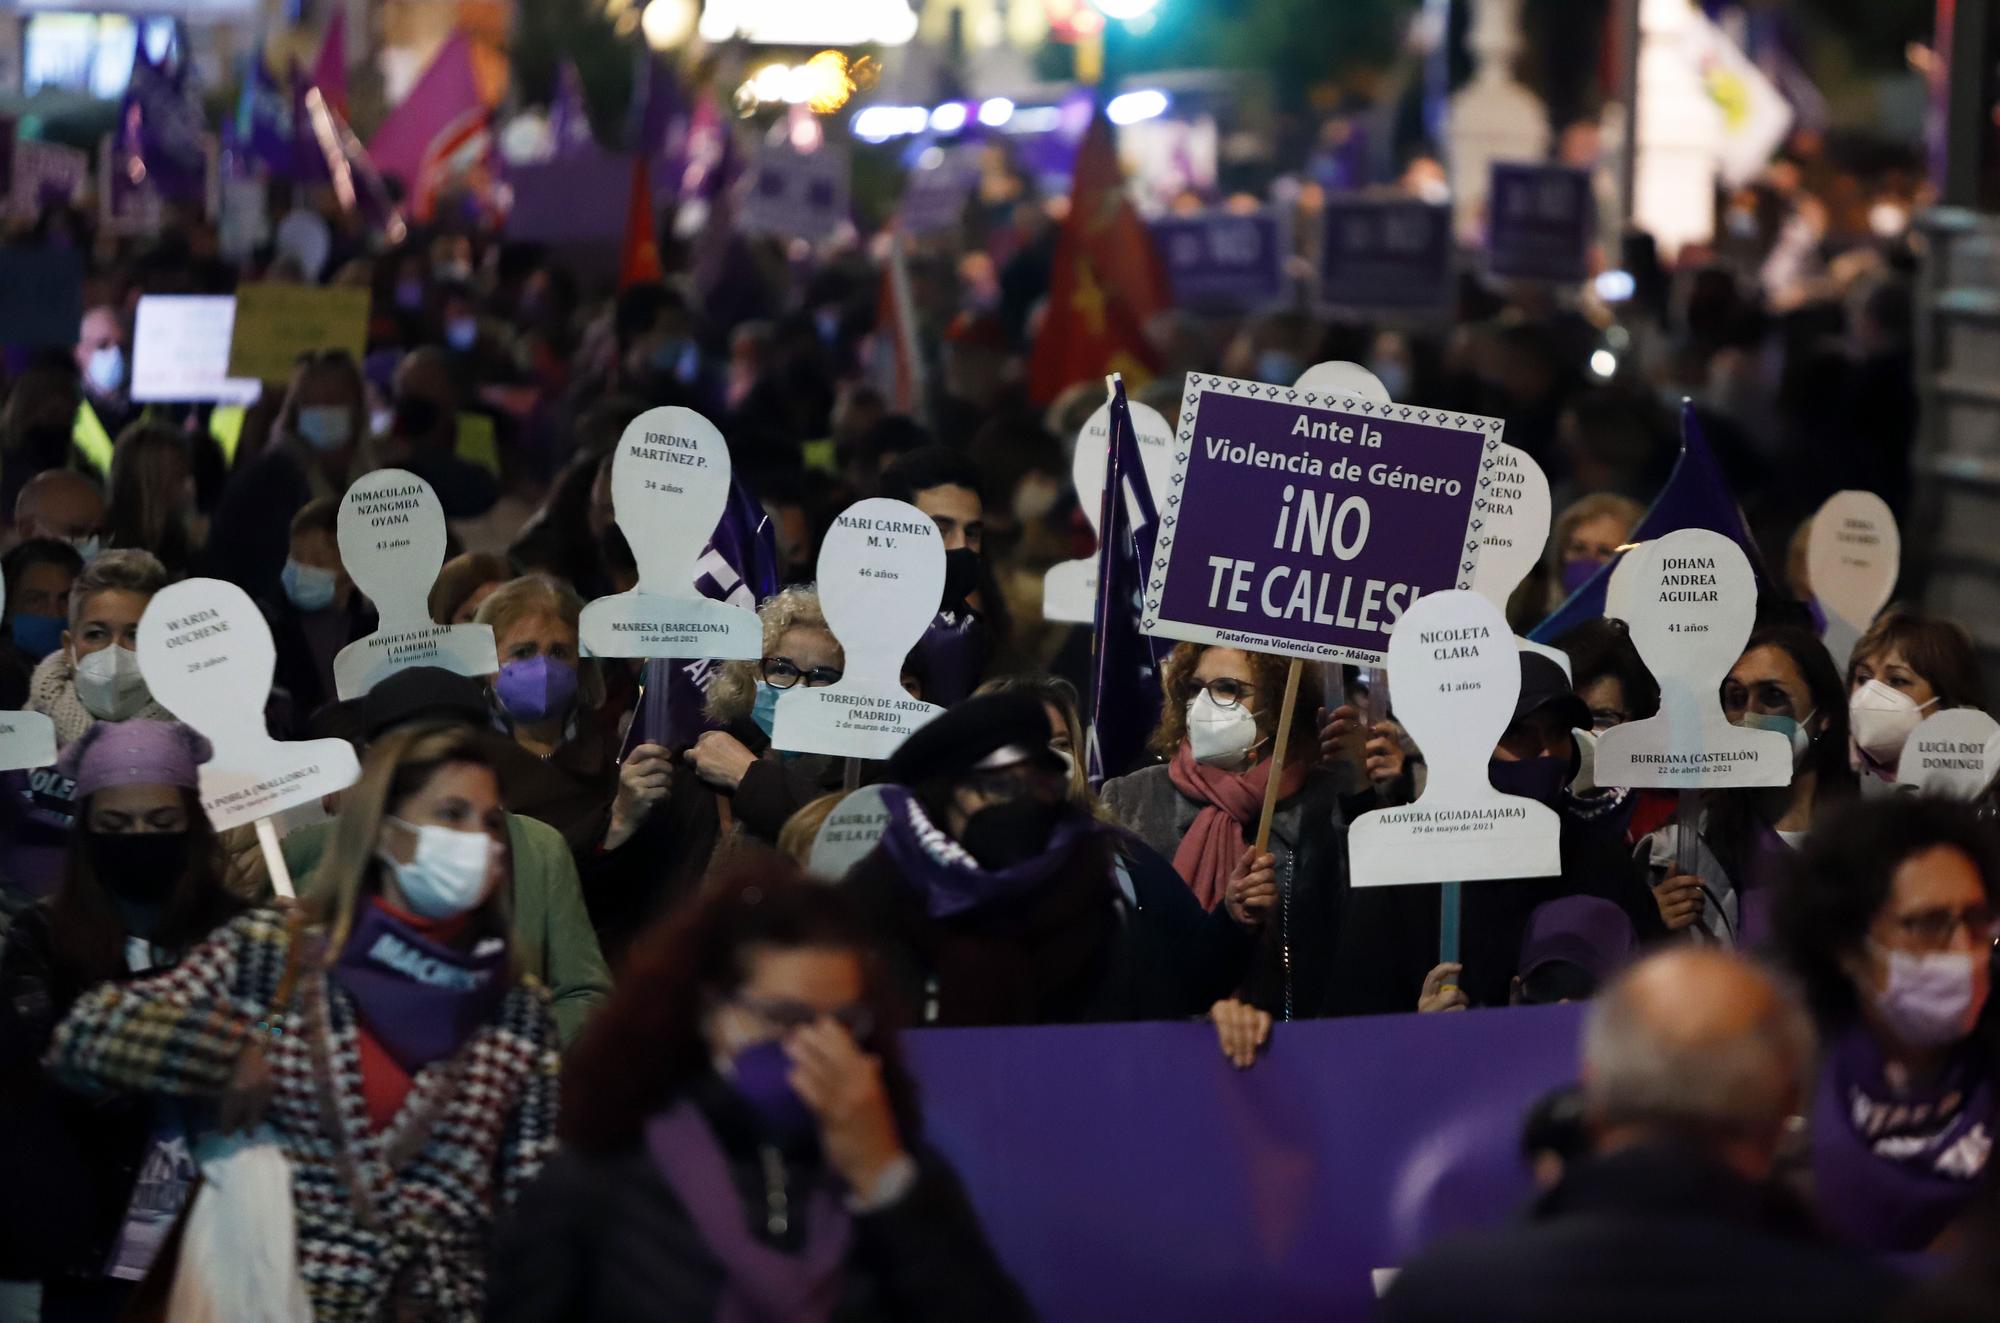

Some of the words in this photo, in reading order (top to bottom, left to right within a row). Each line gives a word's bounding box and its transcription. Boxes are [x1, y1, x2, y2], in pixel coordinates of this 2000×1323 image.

[1291, 413, 1355, 444] Ante
[1359, 422, 1383, 448] la
[644, 431, 698, 450] JORDINA
[629, 445, 694, 466] MARTÍNEZ
[696, 455, 708, 468] P.
[1205, 436, 1322, 476] Violencia
[1329, 457, 1362, 482] de
[1368, 466, 1462, 497] Género
[1494, 471, 1526, 484] DAD
[350, 484, 424, 503] INMACULADA
[645, 479, 656, 490] 34
[660, 482, 684, 494] años
[358, 498, 420, 516] NZANGMBA
[371, 513, 410, 528] OYANA
[837, 516, 872, 530] MARI
[875, 520, 932, 536] CARMEN
[1273, 484, 1371, 561] ¡NO
[376, 540, 387, 550] 43
[389, 538, 410, 549] años
[867, 535, 882, 547] M.
[886, 537, 897, 549] V.
[1482, 535, 1513, 547] años
[1662, 558, 1716, 572] JOHANA
[858, 568, 872, 577] 46
[874, 569, 899, 580] años
[1660, 574, 1717, 586] ANDREA
[1208, 555, 1256, 613] TE
[1659, 590, 1719, 602] AGUILAR
[612, 622, 659, 632] MANRESA
[661, 623, 729, 635] (BARCELONA)
[1420, 626, 1490, 644] NICOLETA
[1667, 623, 1681, 632] 41
[1684, 623, 1710, 632] años
[368, 631, 417, 649] ROQUETAS
[418, 629, 430, 638] DE
[432, 625, 452, 635] MAR
[680, 635, 698, 643] 2021
[1216, 630, 1269, 646] Plataforma
[1271, 638, 1314, 653] Violencia
[1316, 645, 1339, 657] Cero
[1345, 649, 1381, 664] Málaga
[1434, 645, 1480, 660] CLARA
[1439, 683, 1452, 692] 41
[1455, 681, 1482, 691] años
[820, 692, 875, 707] TORREJÓN
[877, 698, 892, 708] DE
[894, 700, 931, 713] ARDOZ
[848, 709, 901, 725] (MADRID)
[842, 721, 852, 729] de
[879, 724, 889, 732] de
[891, 726, 912, 735] 2021
[1631, 754, 1687, 764] BURRIANA
[1690, 750, 1759, 765] (CASTELLÓN)
[1658, 766, 1668, 774] 22
[1670, 766, 1680, 774] de
[1681, 766, 1700, 774] abril
[1712, 765, 1732, 773] 2021
[1379, 812, 1432, 825] ALOVERA
[1434, 807, 1526, 823] (GUADALAJARA)
[1412, 826, 1423, 834] 29
[1424, 825, 1434, 833] de
[1436, 826, 1459, 834] mayo
[1472, 822, 1494, 831] 2021
